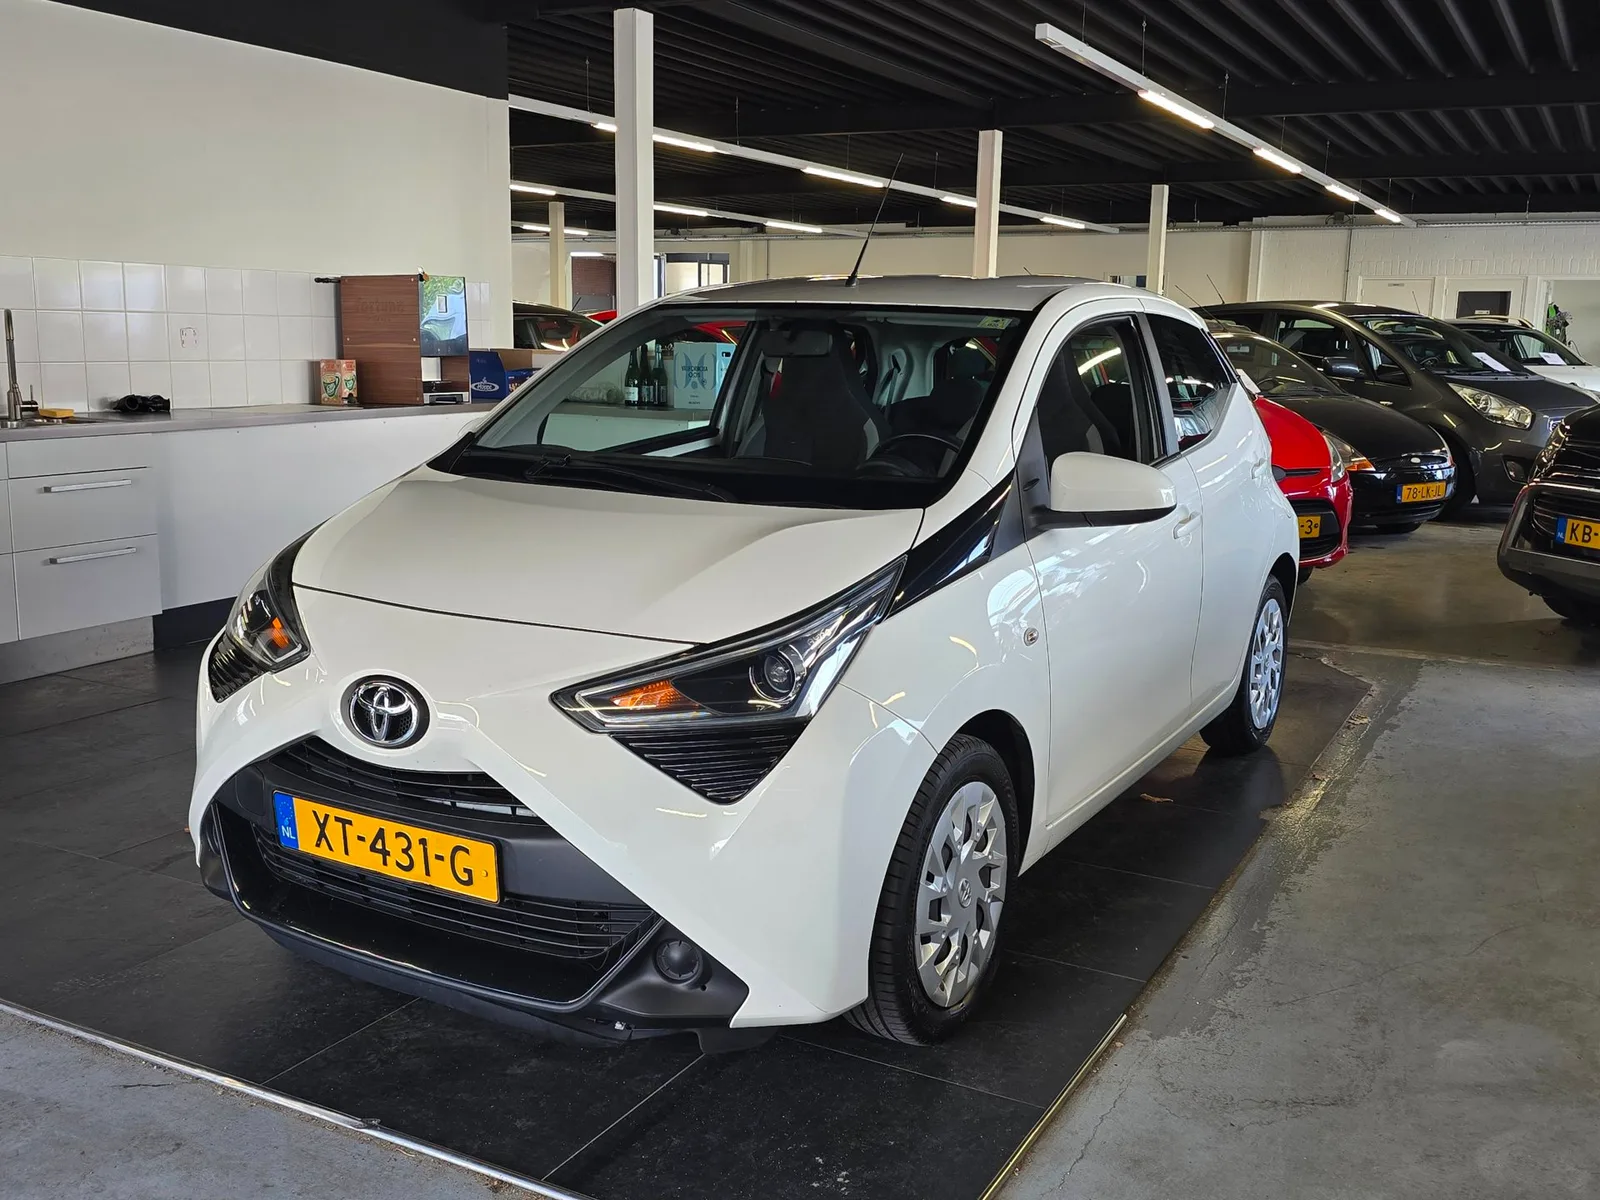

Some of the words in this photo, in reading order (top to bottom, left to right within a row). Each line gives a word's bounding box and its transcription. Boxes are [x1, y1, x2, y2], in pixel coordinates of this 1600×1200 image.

[1406, 484, 1442, 500] 78-LK-JL
[1569, 522, 1599, 544] KB-
[281, 825, 297, 840] NL
[311, 810, 474, 887] XT-431-G
